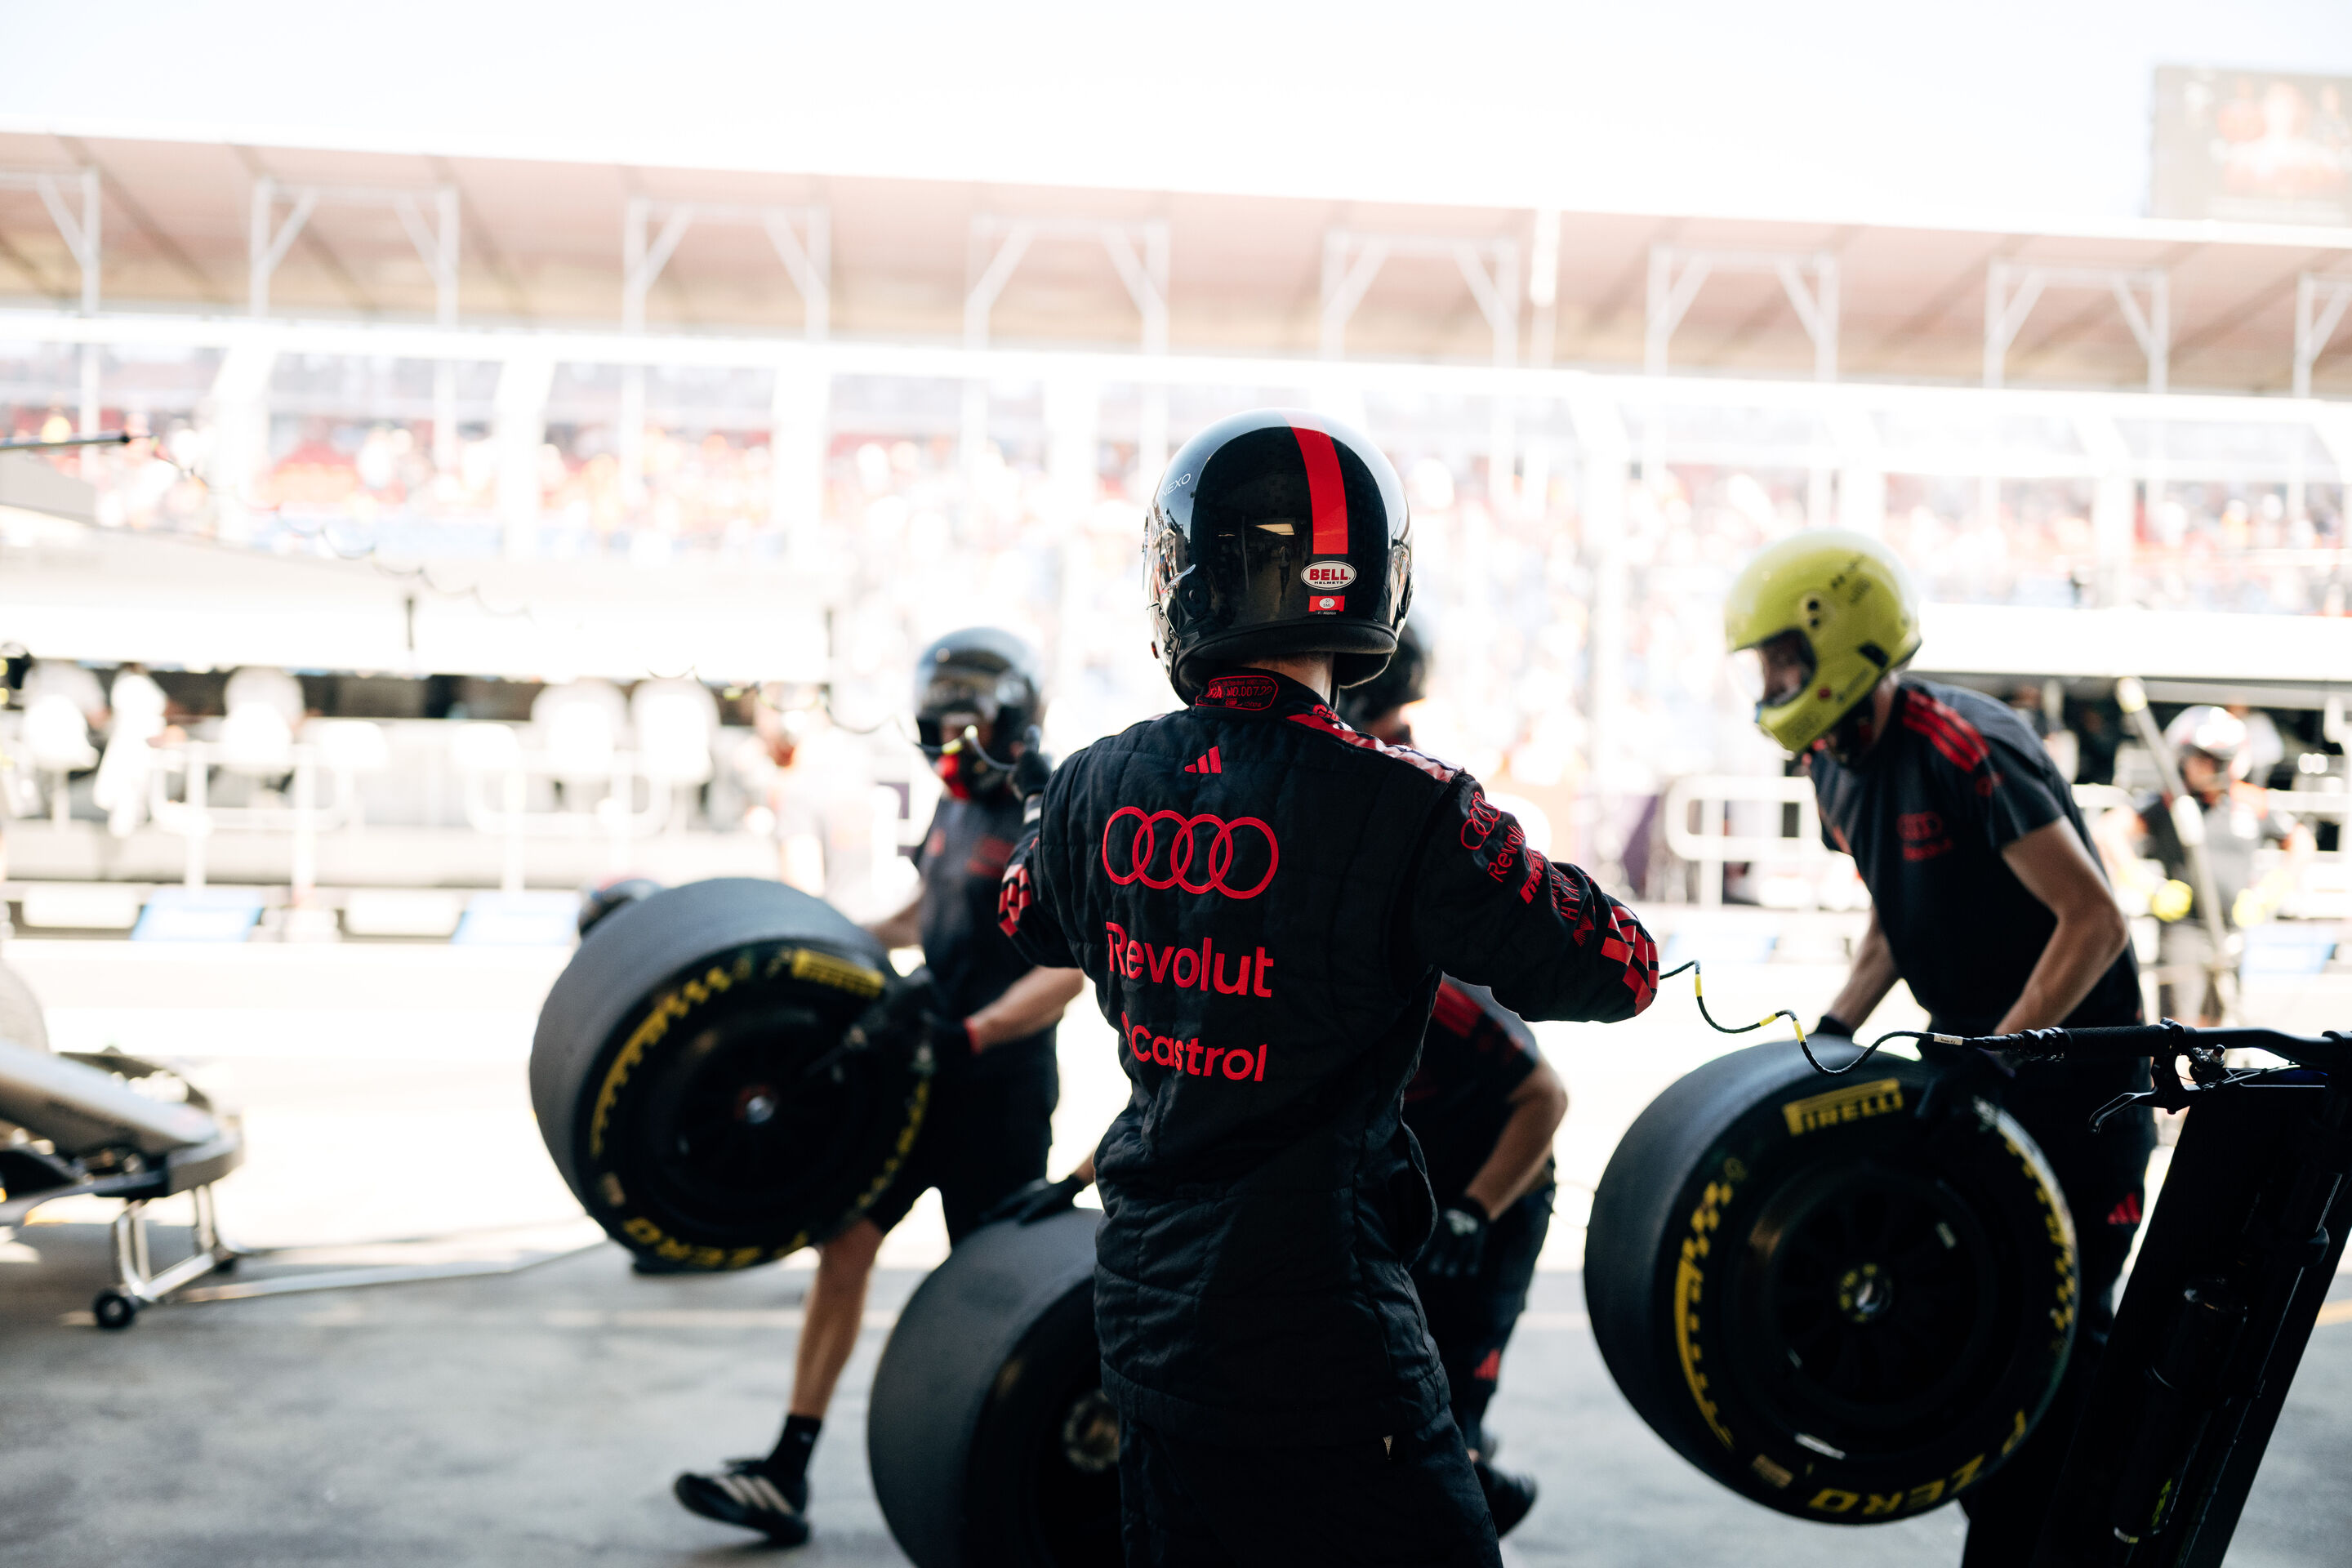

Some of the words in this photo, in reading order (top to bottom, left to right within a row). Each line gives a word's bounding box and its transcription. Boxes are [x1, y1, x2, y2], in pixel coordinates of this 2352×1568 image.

[1161, 473, 1192, 500] NEXO
[1309, 568, 1348, 581] BELL
[1106, 921, 1274, 998] Revolut
[1131, 1024, 1267, 1082] castrol
[1782, 1077, 1904, 1137] PIRELLI
